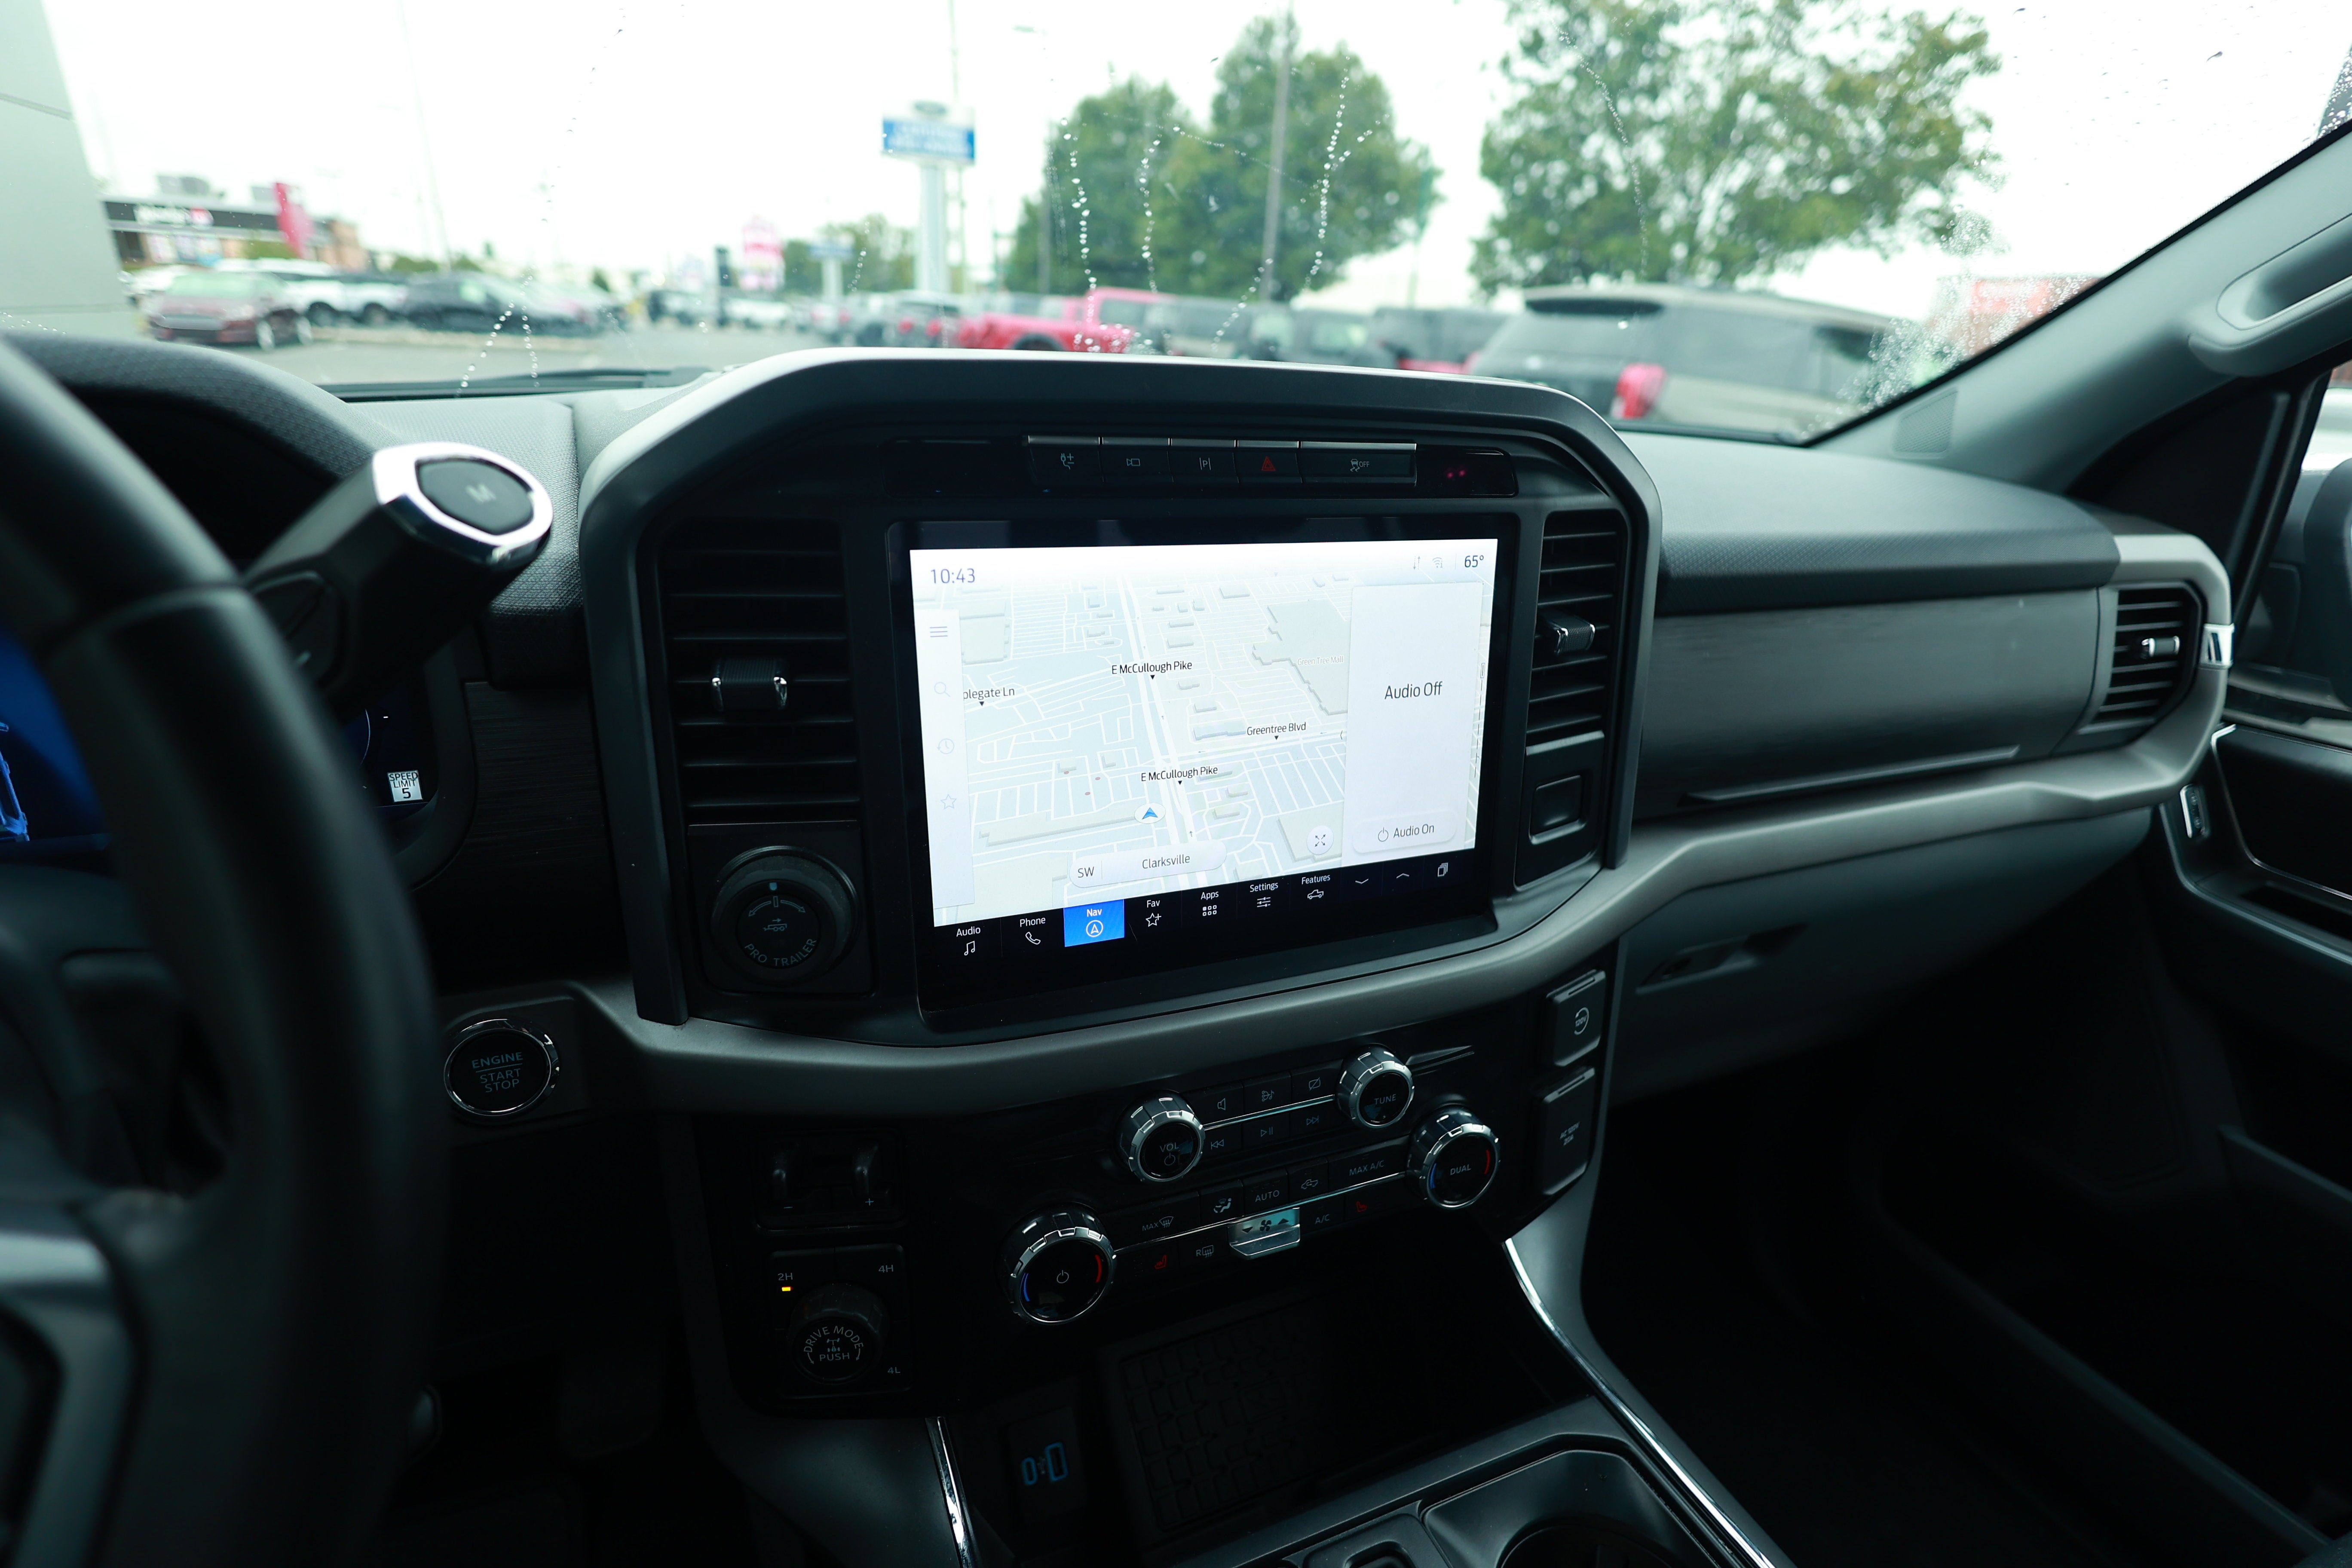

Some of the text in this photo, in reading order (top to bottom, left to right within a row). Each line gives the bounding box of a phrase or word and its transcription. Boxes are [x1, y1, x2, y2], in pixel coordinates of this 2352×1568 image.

[930, 568, 976, 584] 10:43
[1330, 655, 1344, 664] Mall
[1112, 660, 1192, 674] E McCullough Pike
[1003, 687, 1015, 697] Ln
[1384, 680, 1443, 700] Audio Off
[1246, 721, 1307, 735] Greentree Blvd
[389, 772, 419, 781] SPEED
[1141, 766, 1218, 782] E McCullough Pike
[393, 779, 416, 788] LIMIT
[402, 787, 411, 799] 5
[1393, 823, 1435, 838] Audio On
[1142, 854, 1191, 869] Clarksville
[1077, 866, 1095, 878] SW
[1301, 874, 1331, 885] Features
[1250, 881, 1279, 893] Settings
[1200, 891, 1219, 900] Apps
[1147, 899, 1161, 908] Fav
[1086, 908, 1102, 917] Nav
[1020, 917, 1046, 928] Phone
[956, 926, 981, 937] Audio
[744, 938, 817, 967] PRO TRAILER
[471, 1052, 524, 1069] ENGINE
[479, 1068, 522, 1084] START
[484, 1078, 520, 1093] STOP
[1373, 1093, 1397, 1106] TUNE
[1160, 1142, 1179, 1153] VOL
[1348, 1160, 1385, 1176] MAX A/C
[1449, 1164, 1472, 1176] DUAL
[1255, 1190, 1280, 1203] AUTO
[1314, 1213, 1331, 1225] A/C
[1142, 1222, 1159, 1232] MAX
[878, 1264, 894, 1273] 4H
[777, 1272, 793, 1281] 2H
[803, 1325, 864, 1353] DRIVE MODE
[819, 1352, 850, 1362] PUSH
